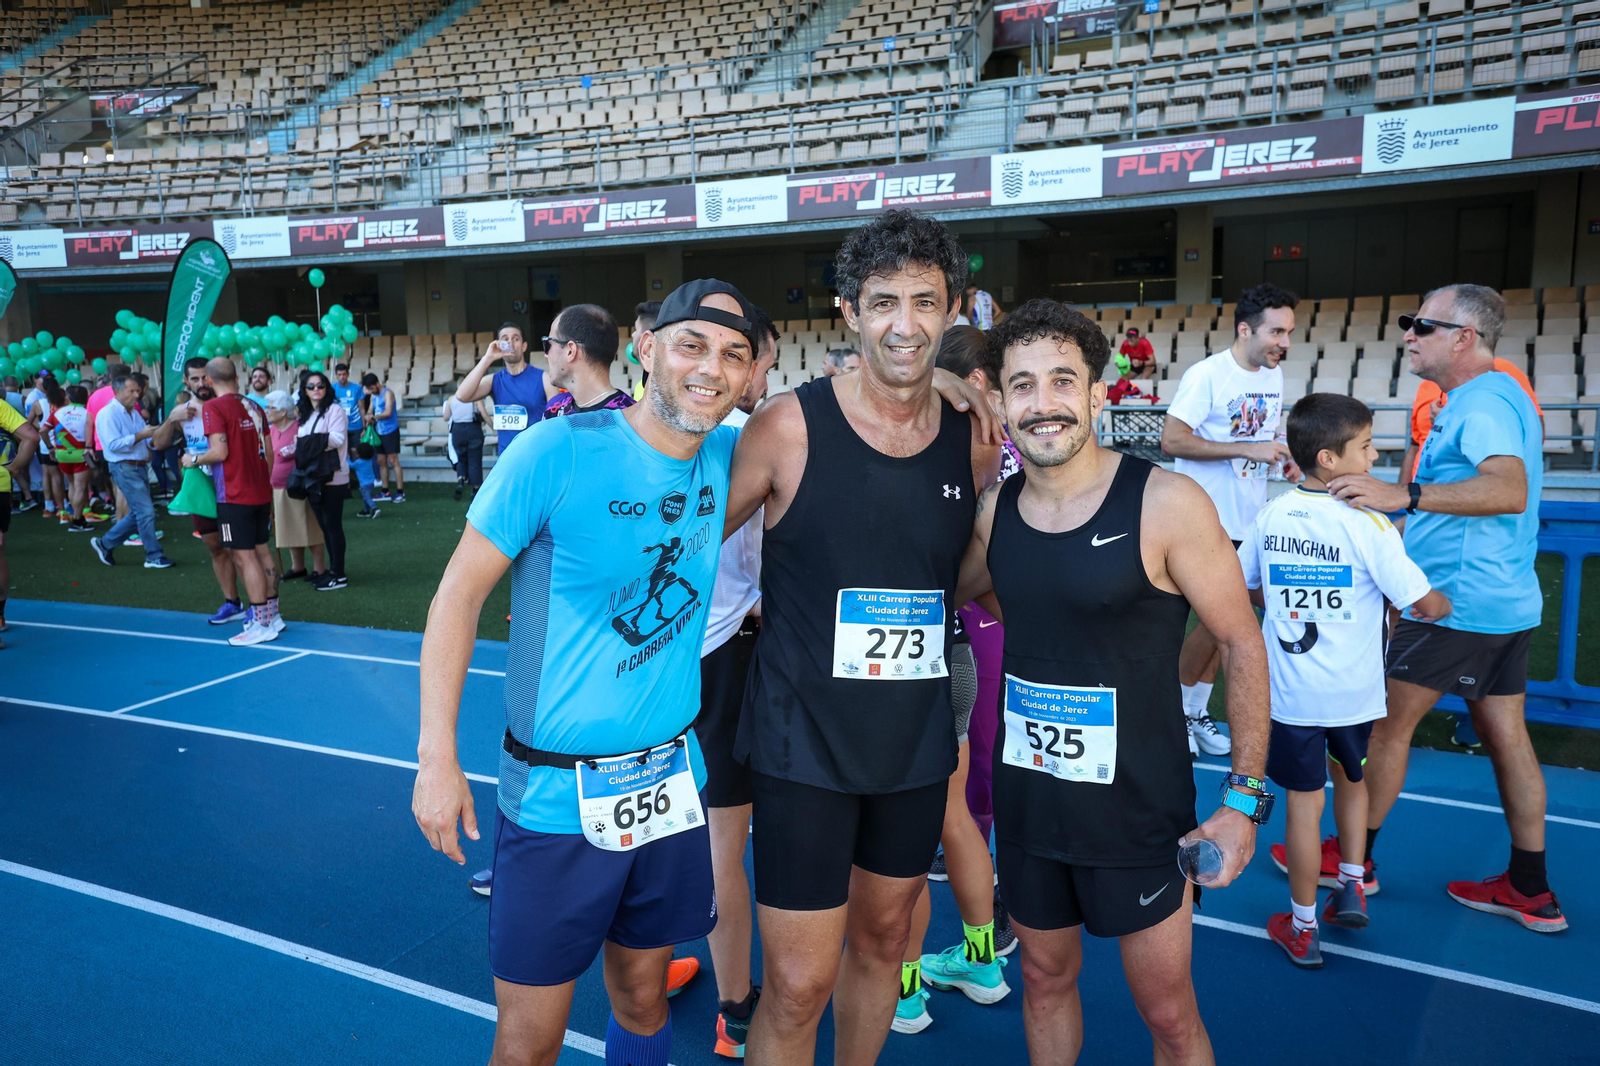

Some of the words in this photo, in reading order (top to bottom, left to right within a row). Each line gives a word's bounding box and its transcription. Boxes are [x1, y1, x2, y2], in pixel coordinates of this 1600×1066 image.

[1001, 4, 1050, 23] PLAY
[1534, 106, 1600, 135] PL
[1413, 123, 1498, 141] Ayuntamiento
[1413, 141, 1426, 149] de
[1428, 138, 1459, 150] Jerez
[1117, 148, 1206, 178] PLAY
[1188, 137, 1317, 183] JEREZ
[1029, 164, 1091, 179] Ayuntamiento
[1029, 178, 1039, 186] de
[1041, 176, 1064, 187] Jerez
[727, 194, 778, 206] Ayuntamiento
[799, 181, 869, 205] PLAY
[856, 172, 956, 210] JEREZ
[534, 205, 594, 227] PLAY
[583, 198, 667, 232] JEREZ
[727, 204, 736, 212] de
[737, 203, 756, 211] Jerez
[472, 216, 516, 225] Ayuntamiento
[481, 224, 497, 232] Jerez
[299, 224, 353, 242] PLAY
[344, 217, 418, 248] JEREZ
[16, 243, 58, 251] Ayuntamiento
[74, 236, 127, 253] PLAY
[119, 230, 190, 260] JEREZ
[172, 277, 205, 372] ESPROHIDENT
[501, 415, 520, 424] 508
[686, 522, 710, 562] 2020
[1264, 535, 1340, 563] BELLINGHAM
[605, 578, 640, 615] JUNIO
[857, 594, 877, 602] XLIII
[879, 594, 911, 603] Carrera
[912, 596, 938, 604] Popular
[1280, 588, 1343, 609] 1216
[865, 606, 898, 615] Ciudad
[899, 607, 910, 615] de
[911, 607, 929, 615] Jerez
[629, 627, 673, 672] CARRERA
[865, 628, 925, 659] 273
[1015, 684, 1029, 695] XLIII
[1029, 690, 1061, 700] Carrera
[1063, 693, 1101, 703] Popular
[1021, 698, 1048, 710] Ciudad
[1049, 704, 1061, 712] de
[1063, 705, 1088, 715] Jerez
[1025, 720, 1085, 759] 525
[597, 764, 619, 774] XLIII
[621, 758, 650, 771] Carra
[651, 747, 677, 762] Popular
[608, 771, 640, 785] Ciudad
[641, 768, 651, 777] de
[652, 762, 671, 774] Jerez
[613, 782, 671, 829] 656
